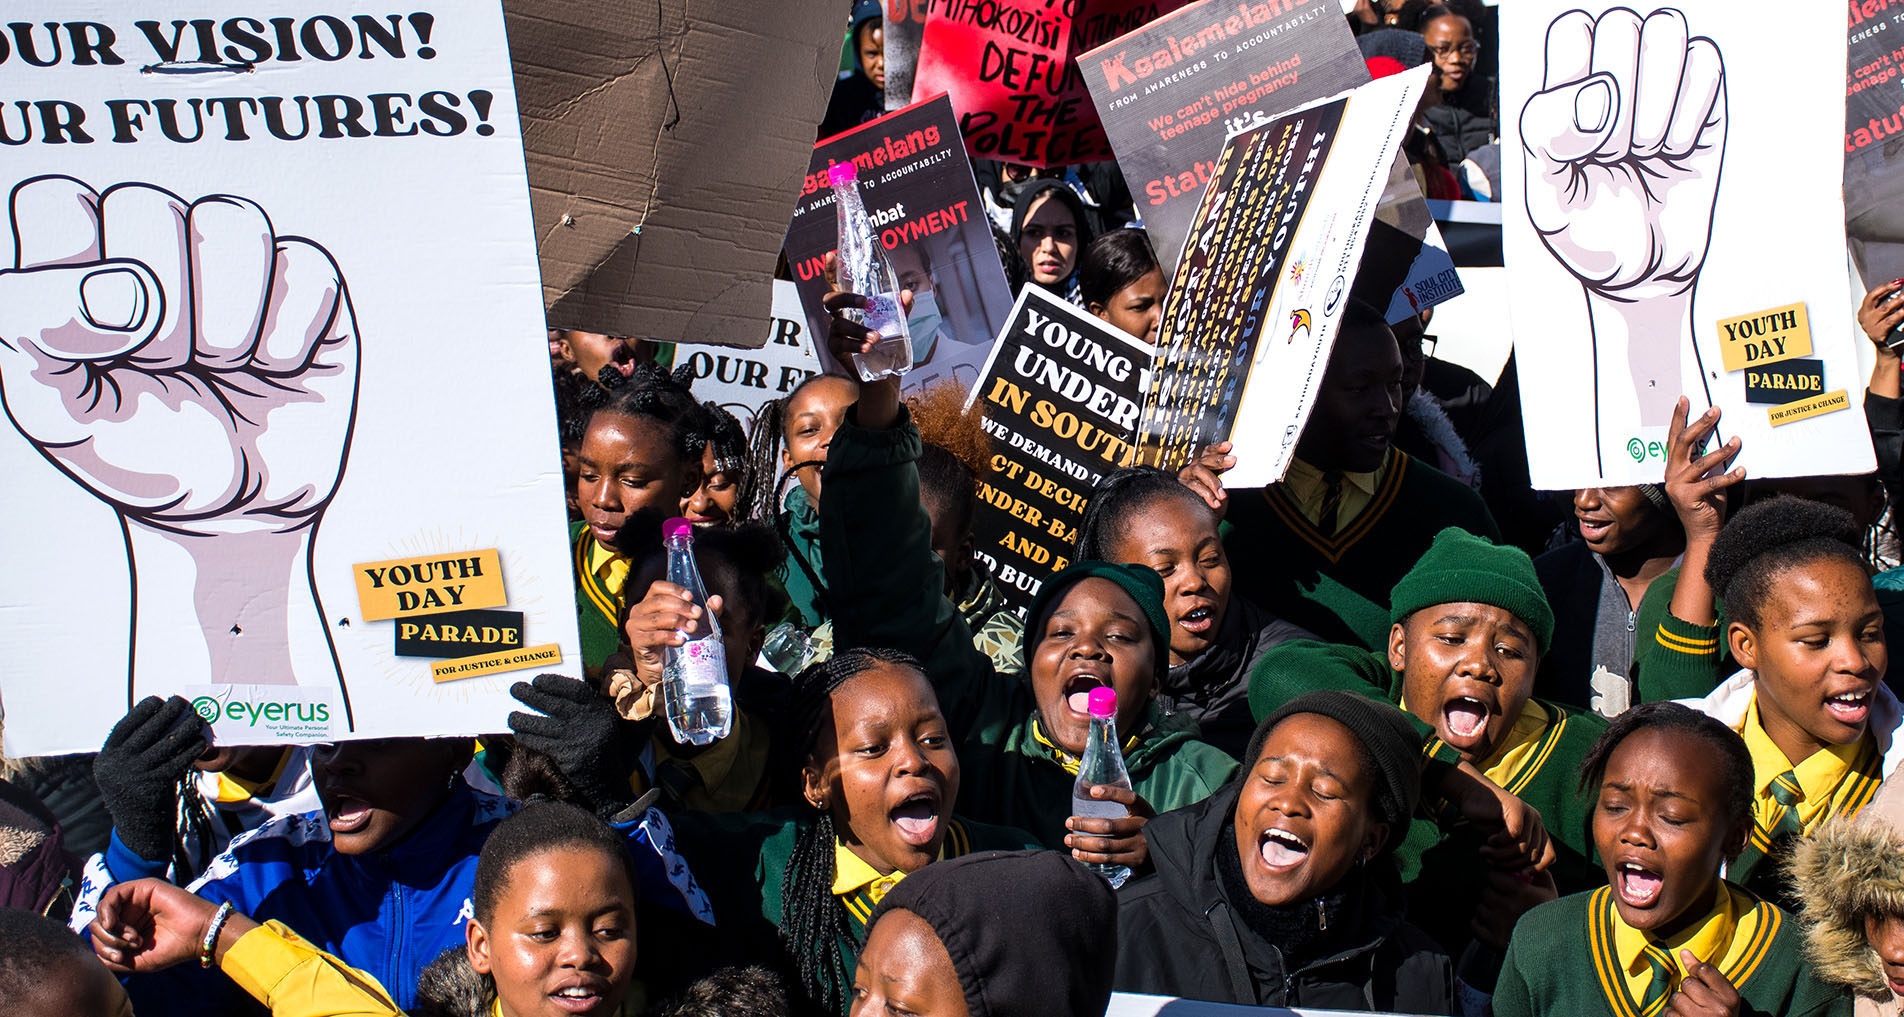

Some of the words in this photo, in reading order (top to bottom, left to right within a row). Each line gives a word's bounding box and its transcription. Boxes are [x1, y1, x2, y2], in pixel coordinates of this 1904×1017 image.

[0, 22, 125, 67] UR
[135, 13, 436, 64] VISION!
[1848, 22, 1887, 45] ENESS
[980, 41, 1088, 96] DEFUN
[1109, 94, 1138, 111] FROM
[1144, 62, 1207, 96] AWARENESS
[1214, 51, 1228, 62] TO
[1847, 67, 1897, 96] eenage
[1855, 55, 1891, 78] can't
[1009, 94, 1082, 126] THE
[1148, 114, 1174, 132] We
[1176, 95, 1213, 120] can't
[1214, 80, 1248, 101] hide
[1250, 53, 1302, 85] behind
[1160, 109, 1220, 141] teenage
[1224, 70, 1299, 115] pregnancy
[0, 100, 94, 145] UR
[105, 90, 495, 144] FUTURES!
[800, 125, 941, 198] gamelang
[810, 194, 837, 211] AWARE
[864, 180, 876, 190] TO
[797, 200, 968, 281] UNOYMENT
[1187, 323, 1203, 371] THAT
[1201, 206, 1241, 320] GOVERNMENT
[1239, 180, 1251, 203] DO
[1249, 130, 1270, 177] MORE
[1203, 325, 1220, 373] AND
[1218, 125, 1292, 319] DISCRIMINATION
[1235, 287, 1266, 366] OUR
[1262, 132, 1325, 277] YOUTH!
[1197, 348, 1221, 421] BUILD
[1220, 326, 1229, 342] A
[1226, 243, 1257, 320] SAFER
[1256, 191, 1277, 238] AND
[1275, 119, 1304, 185] MORE
[1415, 276, 1438, 293] SOUL
[1153, 374, 1173, 425] IS
[1167, 267, 1204, 366] NOT
[1199, 191, 1227, 256] AN
[1169, 425, 1186, 465] TO
[1181, 358, 1204, 417] END
[1201, 296, 1221, 350] ALL
[1217, 187, 1259, 289] FORMS
[1257, 145, 1273, 181] OF
[1210, 310, 1244, 406] EQUAL
[1241, 182, 1291, 303] SOCIETY
[1024, 308, 1133, 384] YOUNG
[1724, 310, 1797, 342] YOUTH
[1745, 336, 1787, 361] DAY
[688, 351, 769, 389] OUR
[1014, 344, 1141, 432] UNDER
[1153, 309, 1197, 468] SOLATED
[1748, 372, 1821, 391] PARADE
[987, 377, 1032, 415] IN
[1771, 412, 1784, 421] FOR
[1785, 406, 1811, 418] JUSTICE
[1818, 395, 1846, 409] CHANGE
[981, 415, 1009, 440] WE
[1009, 432, 1089, 481] DEMAND
[999, 531, 1050, 564] AND
[365, 557, 484, 589] YOUTH
[999, 564, 1042, 597] BUI
[398, 585, 467, 611] DAY
[401, 622, 519, 645] PARADE
[435, 666, 457, 676] FOR
[459, 659, 502, 673] JUSTICE
[504, 657, 512, 666] &
[513, 650, 556, 664] CHANGE
[226, 701, 330, 727] eyerus
